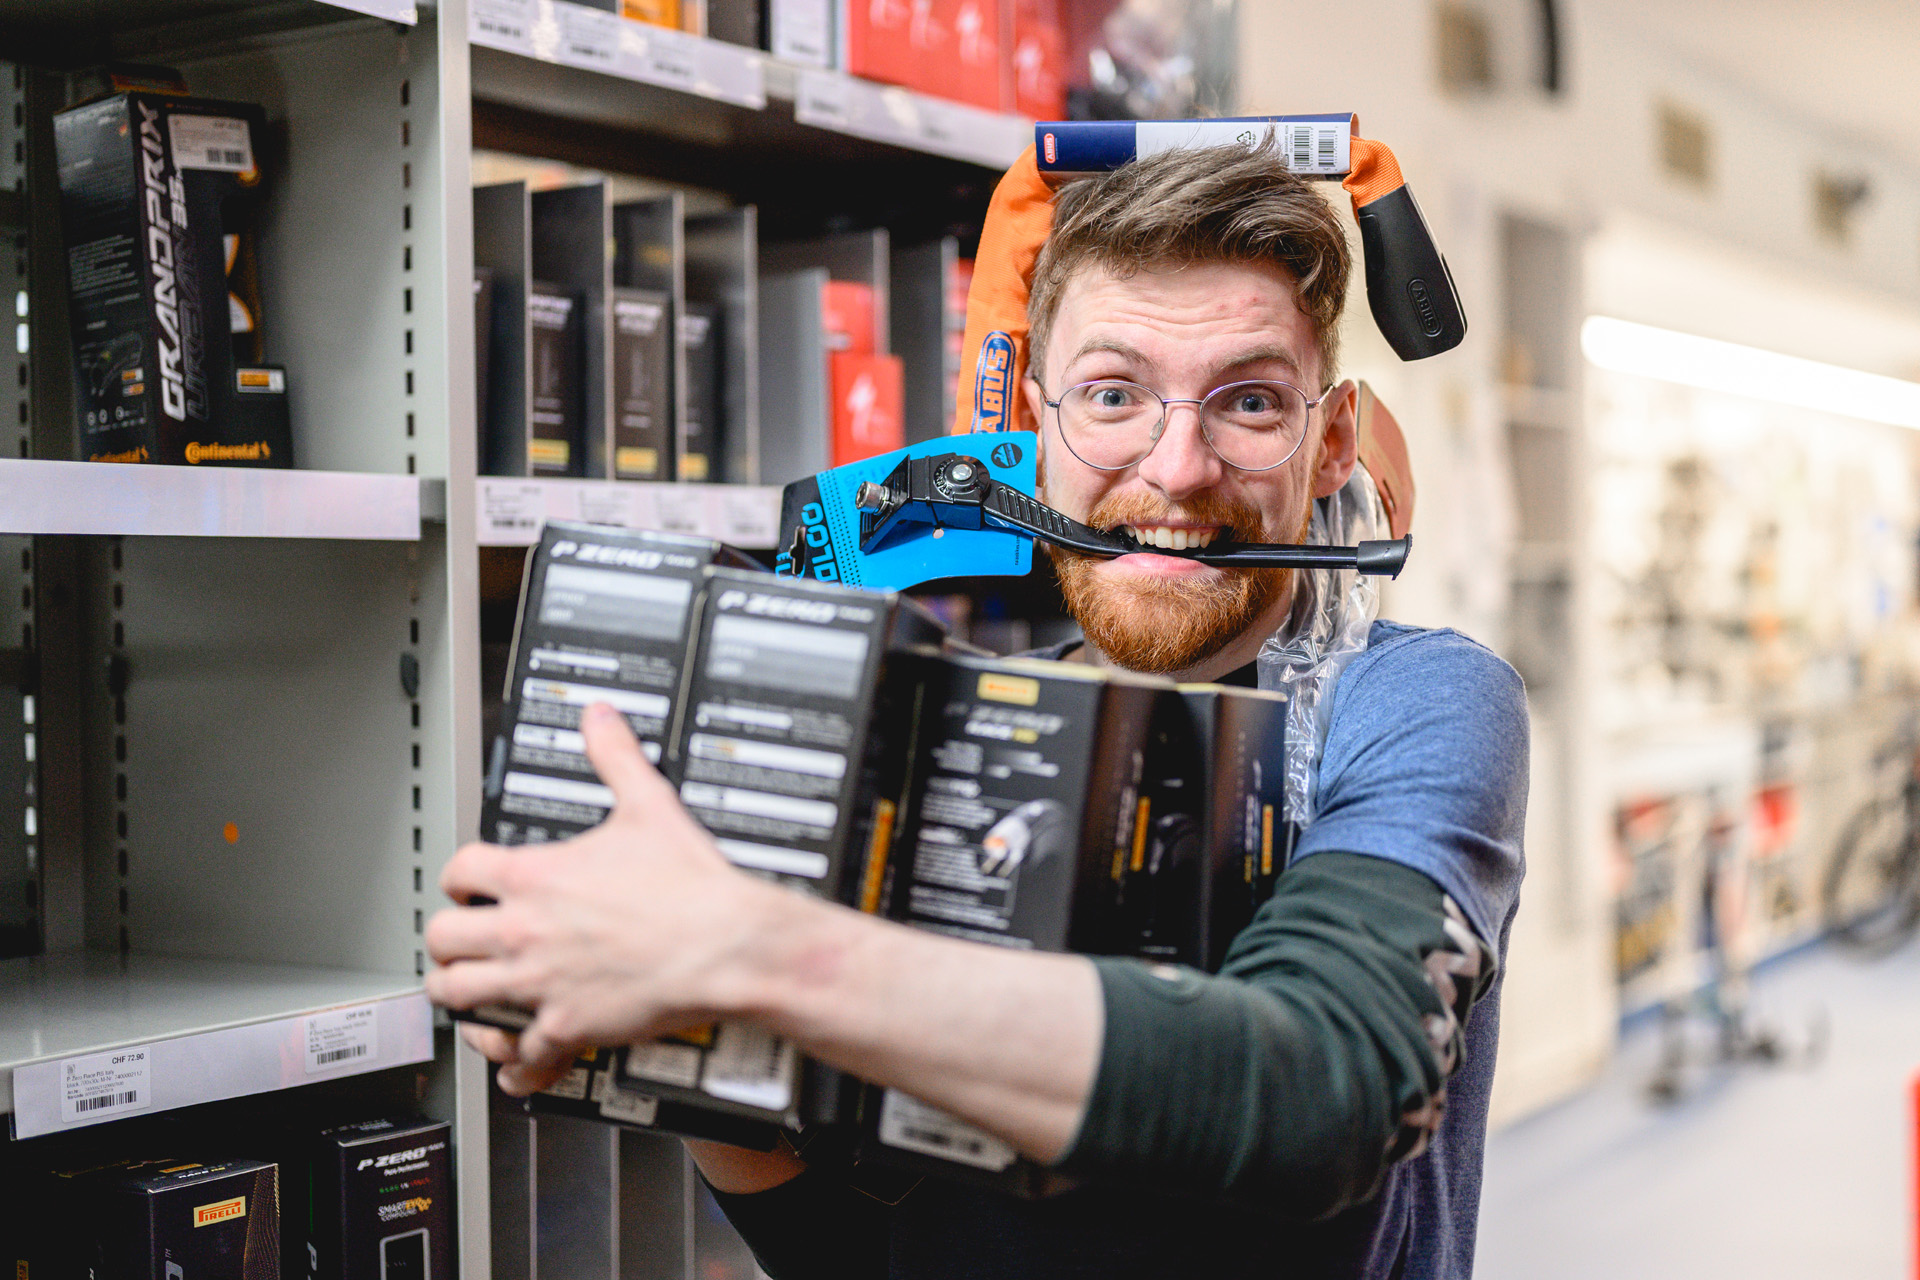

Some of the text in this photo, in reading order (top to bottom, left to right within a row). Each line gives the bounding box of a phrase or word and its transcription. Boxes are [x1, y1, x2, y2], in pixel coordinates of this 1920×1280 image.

[1412, 286, 1436, 330] ABUS
[980, 347, 1010, 433] ABUS
[185, 441, 260, 464] Continental
[551, 540, 578, 558] P
[575, 542, 664, 570] ZERO
[717, 589, 748, 611] P
[743, 592, 838, 624] ZERO
[112, 1052, 144, 1064] CHF 72.90
[356, 1158, 374, 1172] P
[374, 1146, 427, 1168] ZERO
[198, 1201, 242, 1223] PIRELLI
